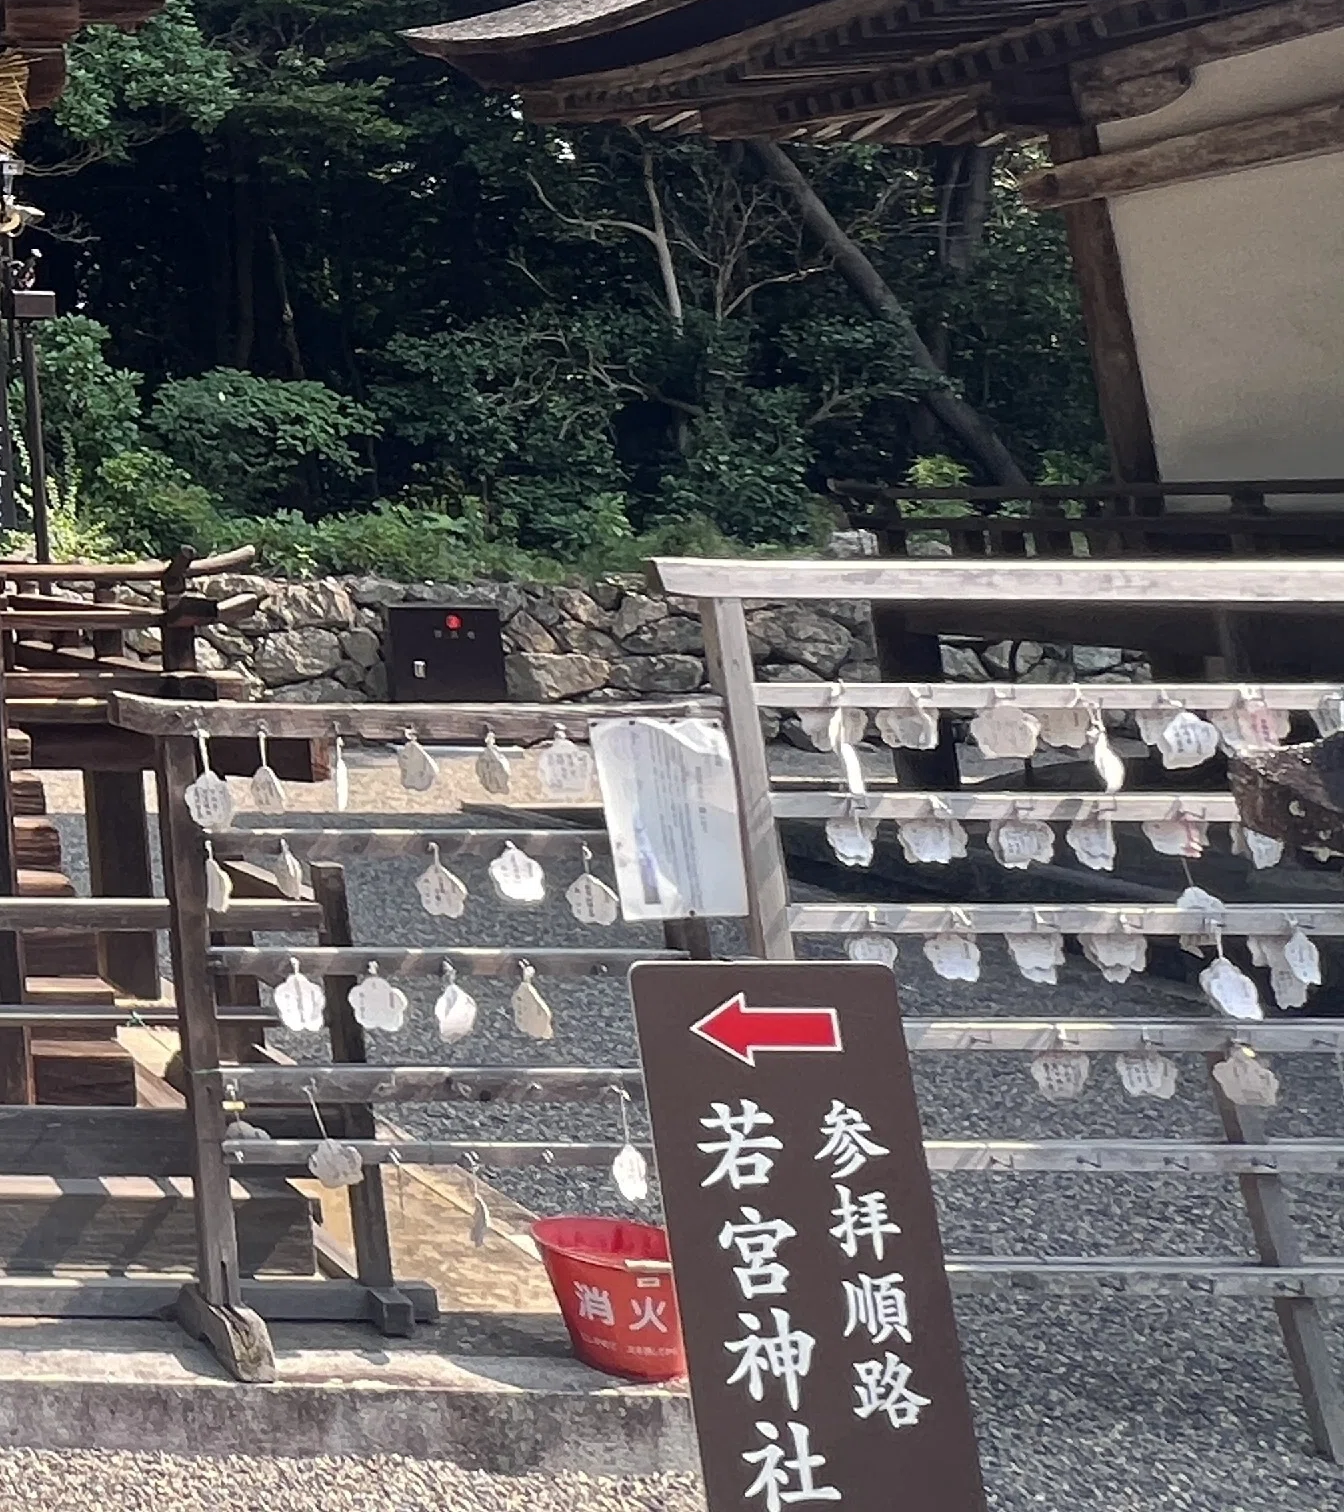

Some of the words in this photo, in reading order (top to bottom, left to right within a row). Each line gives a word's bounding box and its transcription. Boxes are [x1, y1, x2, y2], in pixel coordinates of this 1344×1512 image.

[573, 1280, 668, 1334] 消火
[696, 1098, 842, 1512] 若宮神社
[814, 1099, 932, 1429] 参拝順路
